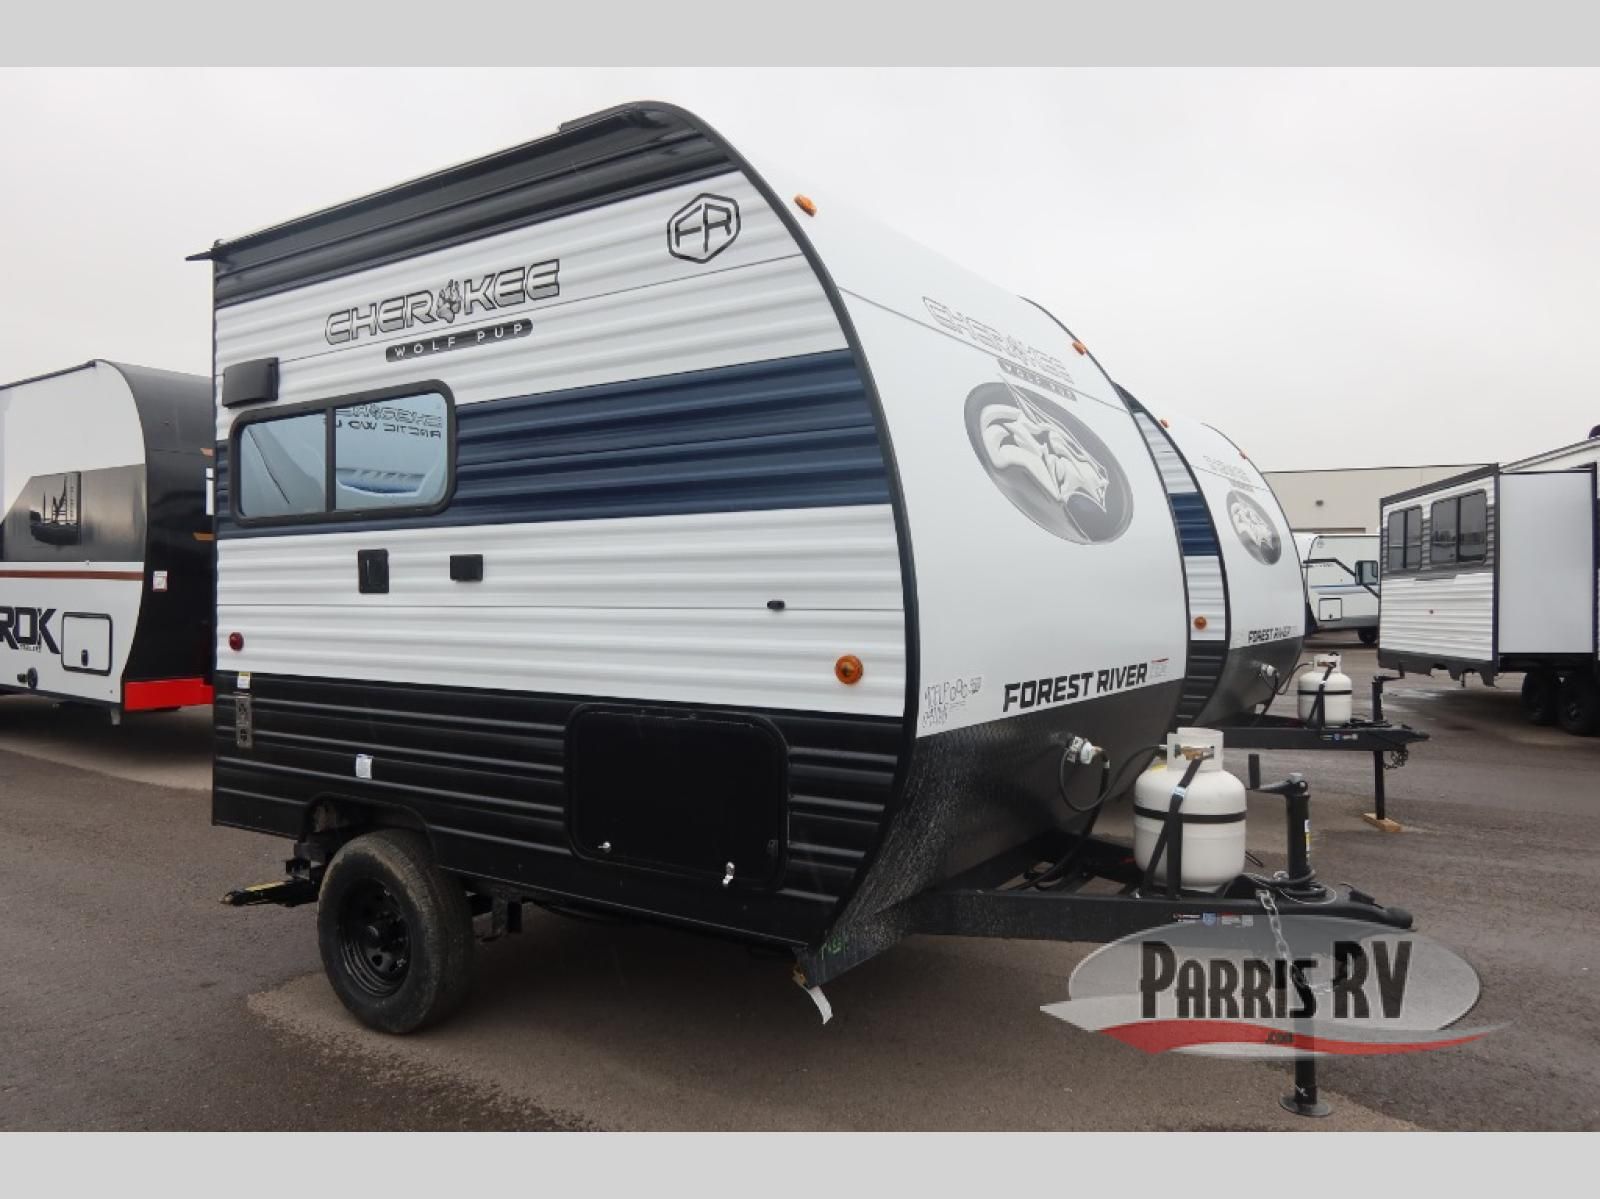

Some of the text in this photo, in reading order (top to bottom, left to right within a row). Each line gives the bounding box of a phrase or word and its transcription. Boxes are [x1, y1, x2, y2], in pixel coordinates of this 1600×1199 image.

[395, 322, 523, 357] WOLF PUP
[1002, 671, 1094, 712] FOREST
[1097, 663, 1148, 693] RIVER
